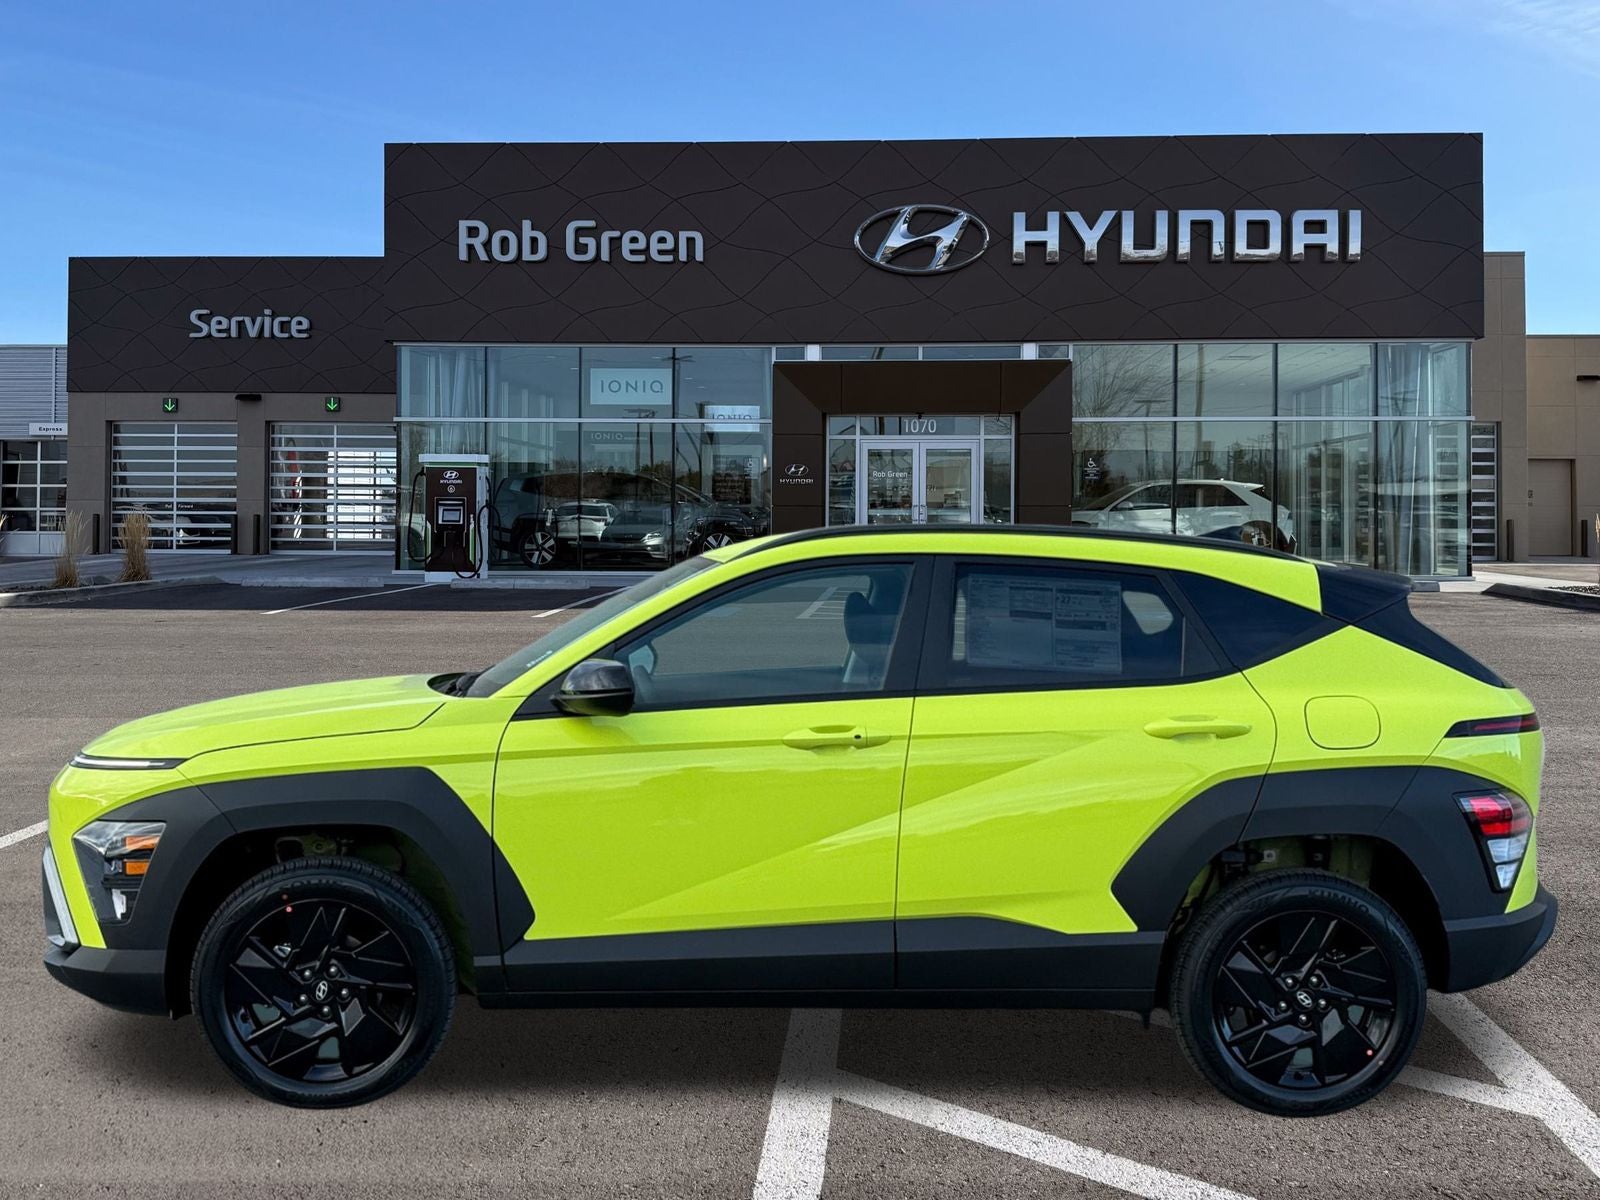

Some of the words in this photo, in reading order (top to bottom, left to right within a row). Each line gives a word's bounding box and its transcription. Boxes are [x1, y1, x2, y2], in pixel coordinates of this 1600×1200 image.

[458, 219, 548, 262] Rob
[565, 219, 704, 262] Green
[1011, 209, 1363, 263] HYUNDAI
[189, 308, 311, 338] Service
[600, 379, 664, 393] IONIQ
[903, 419, 937, 433] 1070
[591, 432, 625, 440] IONIQ
[872, 470, 886, 478] Rob
[887, 470, 908, 478] Green
